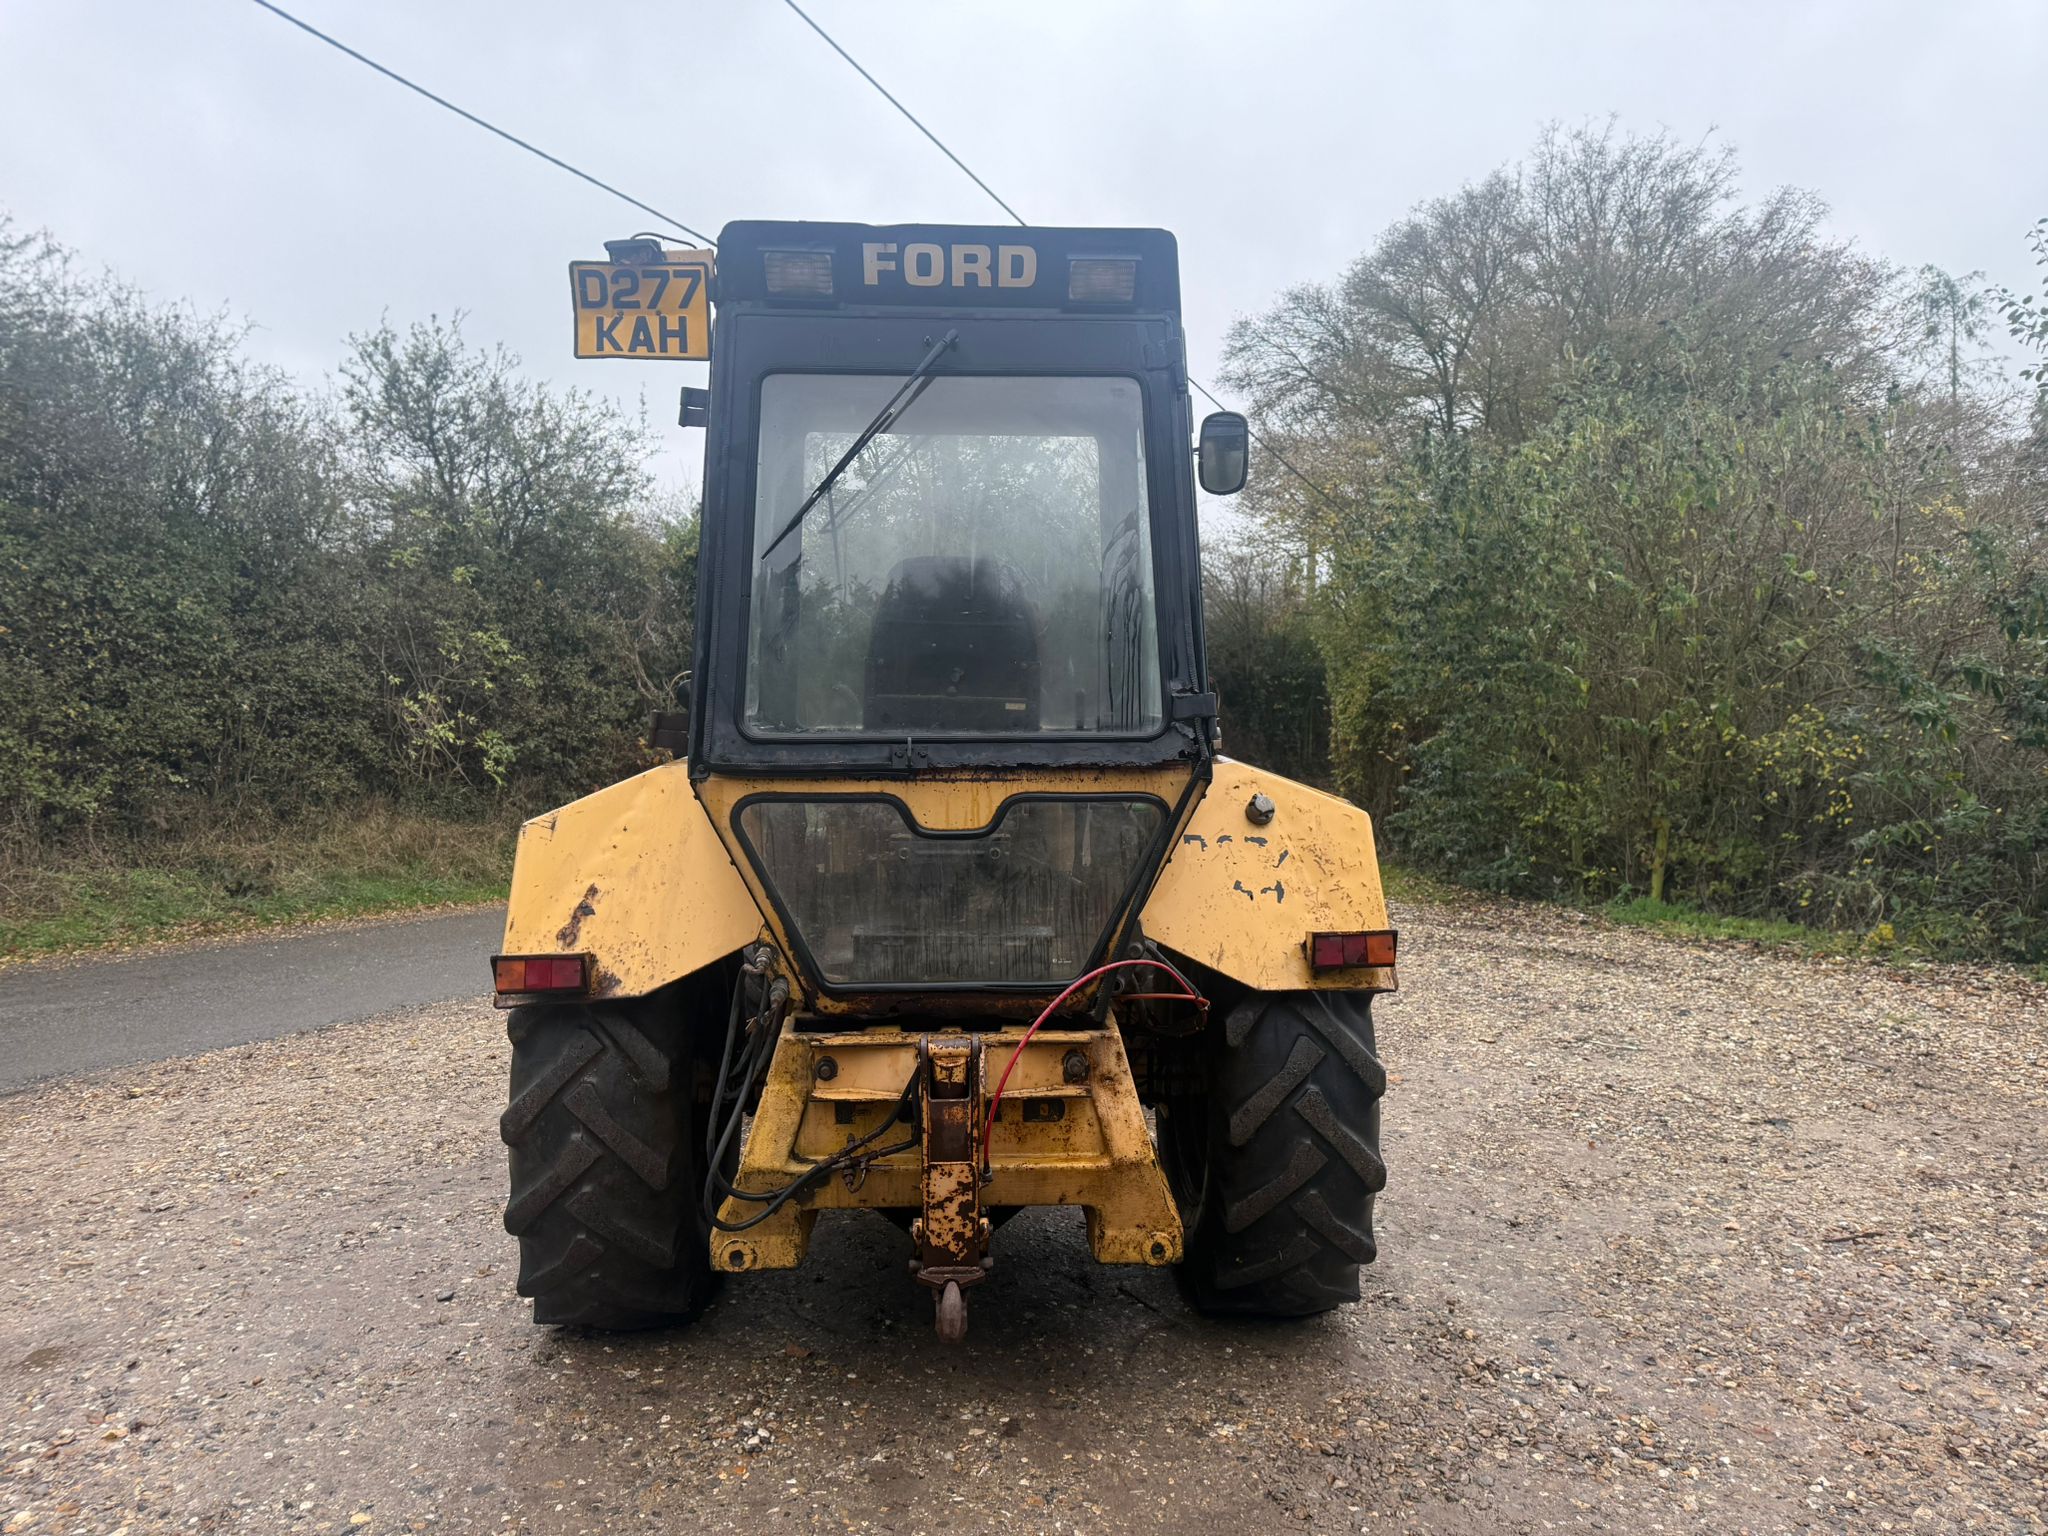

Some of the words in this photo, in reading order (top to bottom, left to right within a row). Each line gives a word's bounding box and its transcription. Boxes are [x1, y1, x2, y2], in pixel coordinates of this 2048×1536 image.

[862, 242, 1037, 288] FORD
[577, 269, 702, 310] D277
[596, 315, 688, 353] KAH
